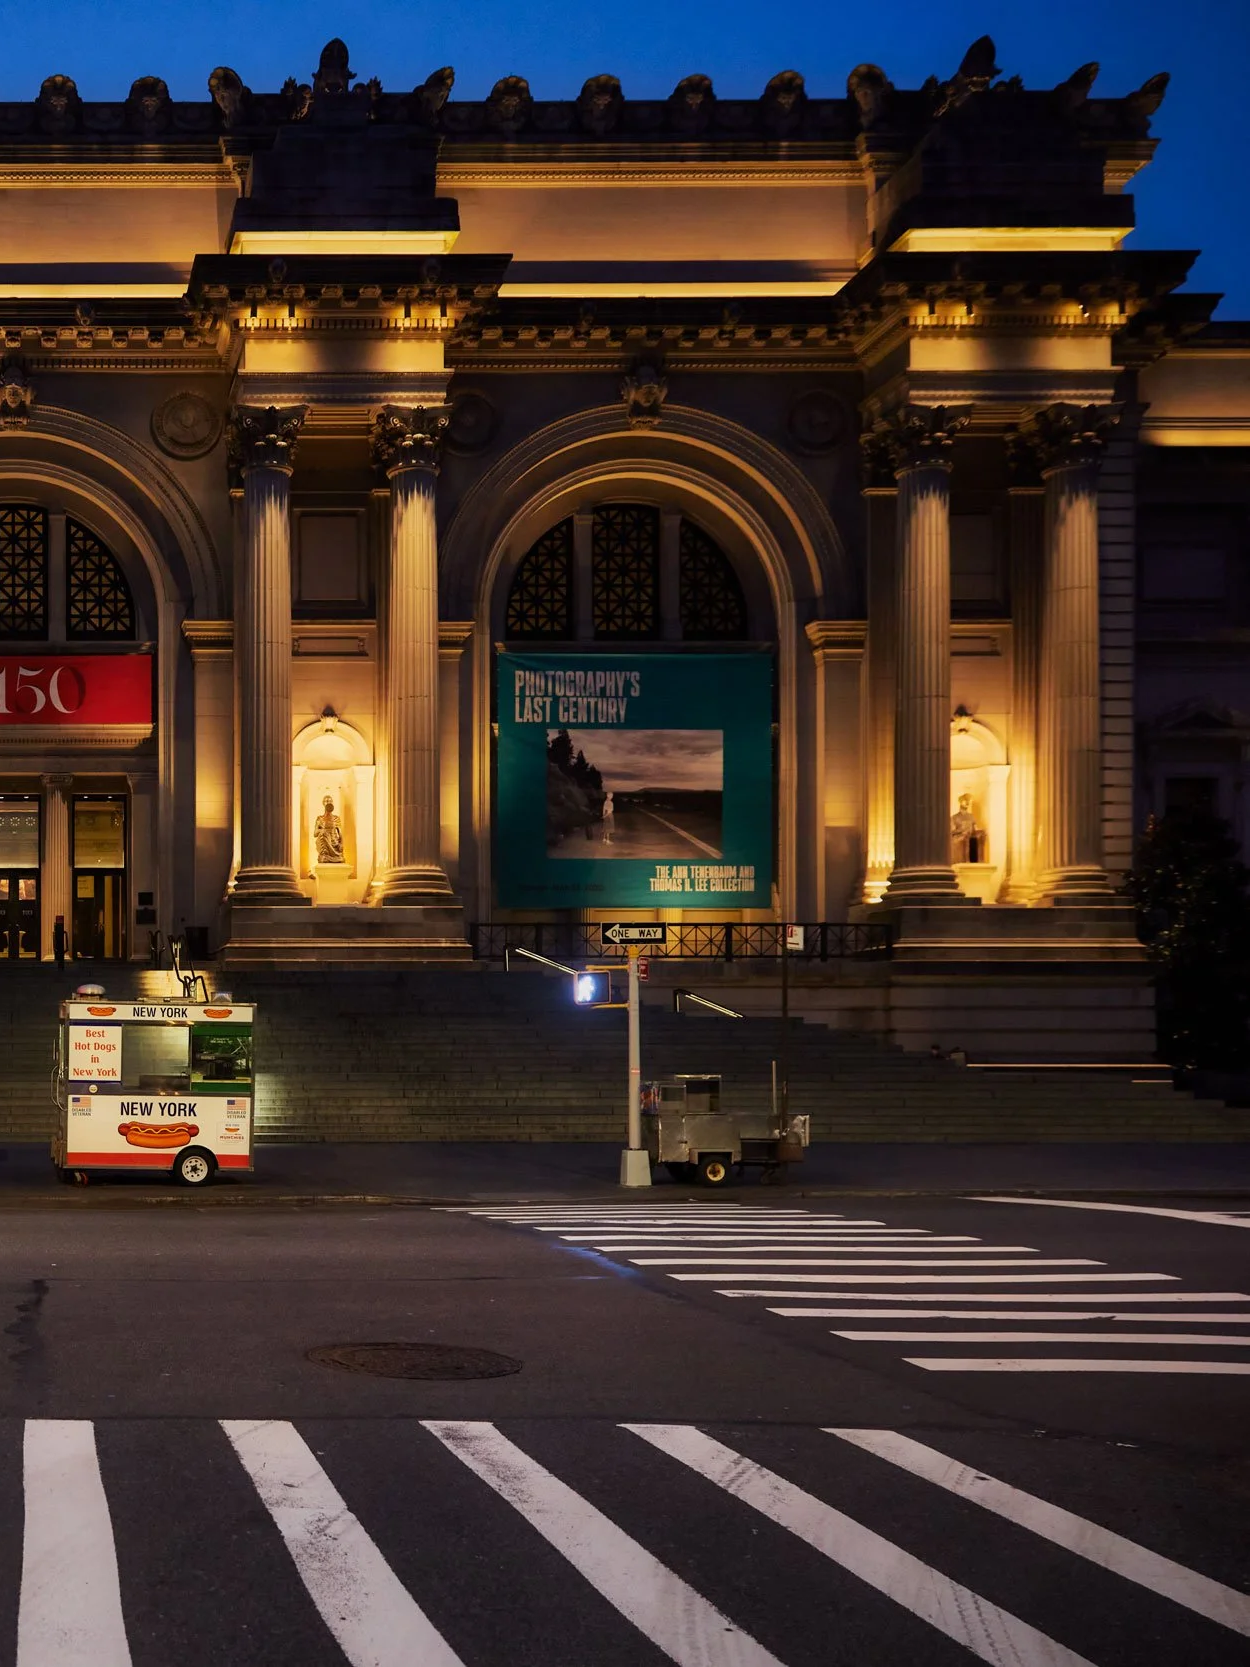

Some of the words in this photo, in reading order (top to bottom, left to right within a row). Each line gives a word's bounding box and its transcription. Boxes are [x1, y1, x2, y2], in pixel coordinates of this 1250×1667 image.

[514, 670, 641, 697] PHOTOGRAPHY'S
[514, 697, 553, 723] LAST
[558, 697, 628, 723] CENTURY
[655, 865, 670, 878] THE
[650, 878, 683, 892] THOMAS
[695, 878, 708, 892] LEE
[710, 878, 755, 892] COLLECTION
[611, 929, 630, 938] ONE
[638, 929, 658, 938] WAY
[132, 1006, 156, 1018] NEW
[159, 1007, 188, 1018] YORK
[85, 1029, 105, 1038] Best
[74, 1042, 92, 1051] Hot
[93, 1042, 117, 1053] Dogs
[91, 1055, 99, 1064] in
[72, 1068, 94, 1076] New
[96, 1068, 118, 1077] York
[120, 1102, 154, 1116] NEW
[158, 1102, 198, 1117] YORK
